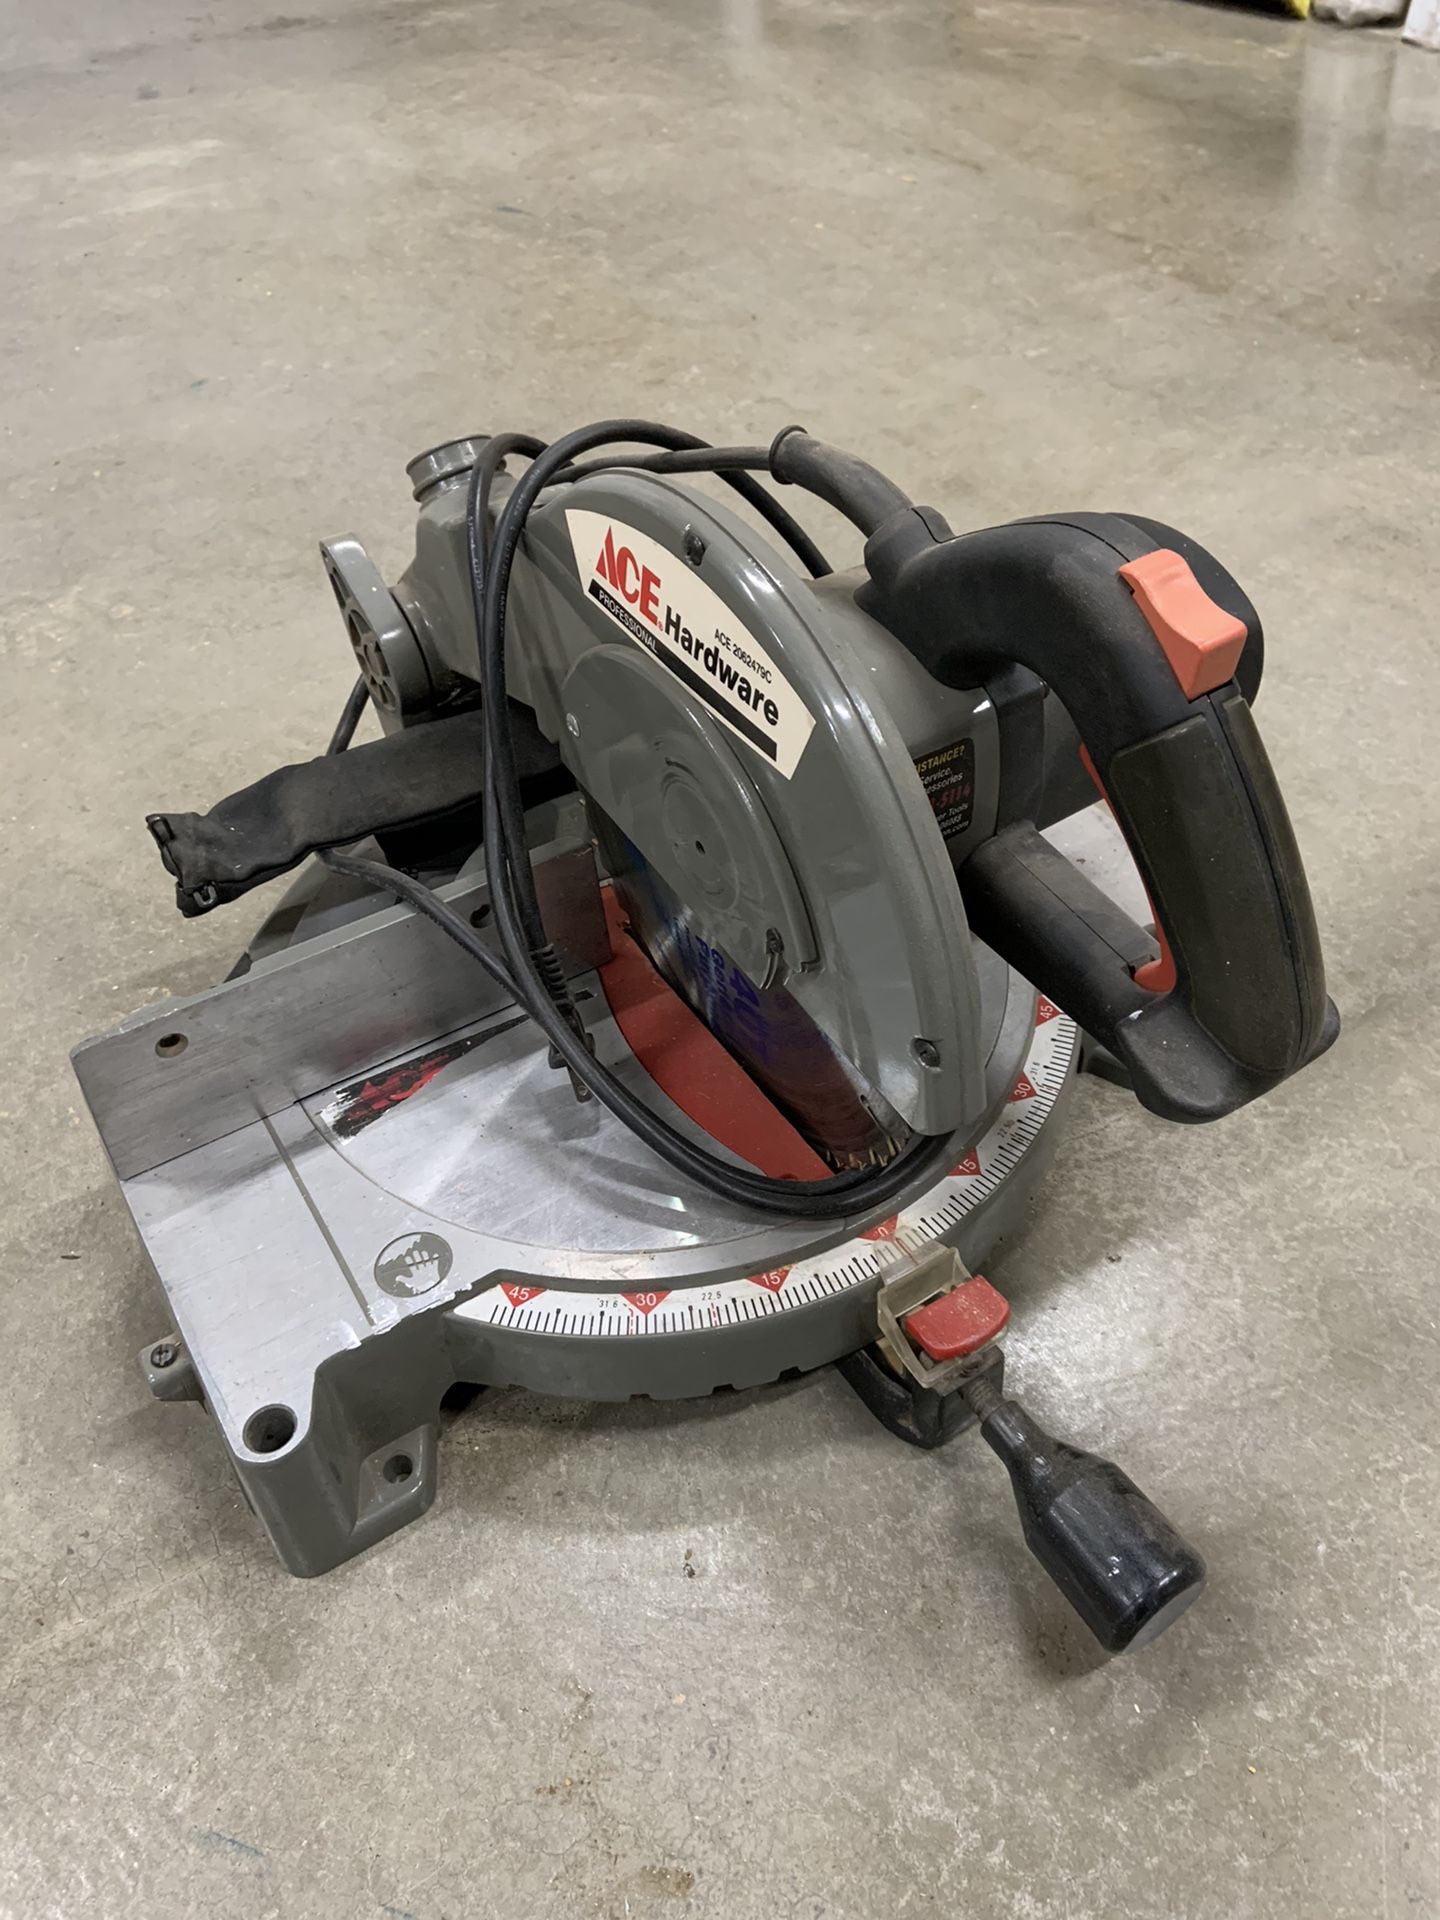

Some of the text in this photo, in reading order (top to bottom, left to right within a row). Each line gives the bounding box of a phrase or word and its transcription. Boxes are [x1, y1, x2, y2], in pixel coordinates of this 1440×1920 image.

[595, 525, 661, 627] ACE
[664, 604, 779, 726] Hardware
[598, 589, 659, 655] PROFESSIONAL
[714, 628, 772, 684] ACE 2062479C
[1039, 1004, 1054, 1019] 45
[1014, 1082, 1032, 1098] 30
[958, 1158, 977, 1174] 15
[761, 1271, 781, 1286] 15
[508, 1285, 531, 1301] 45
[635, 1292, 657, 1307] 30
[701, 1290, 722, 1301] 22.5
